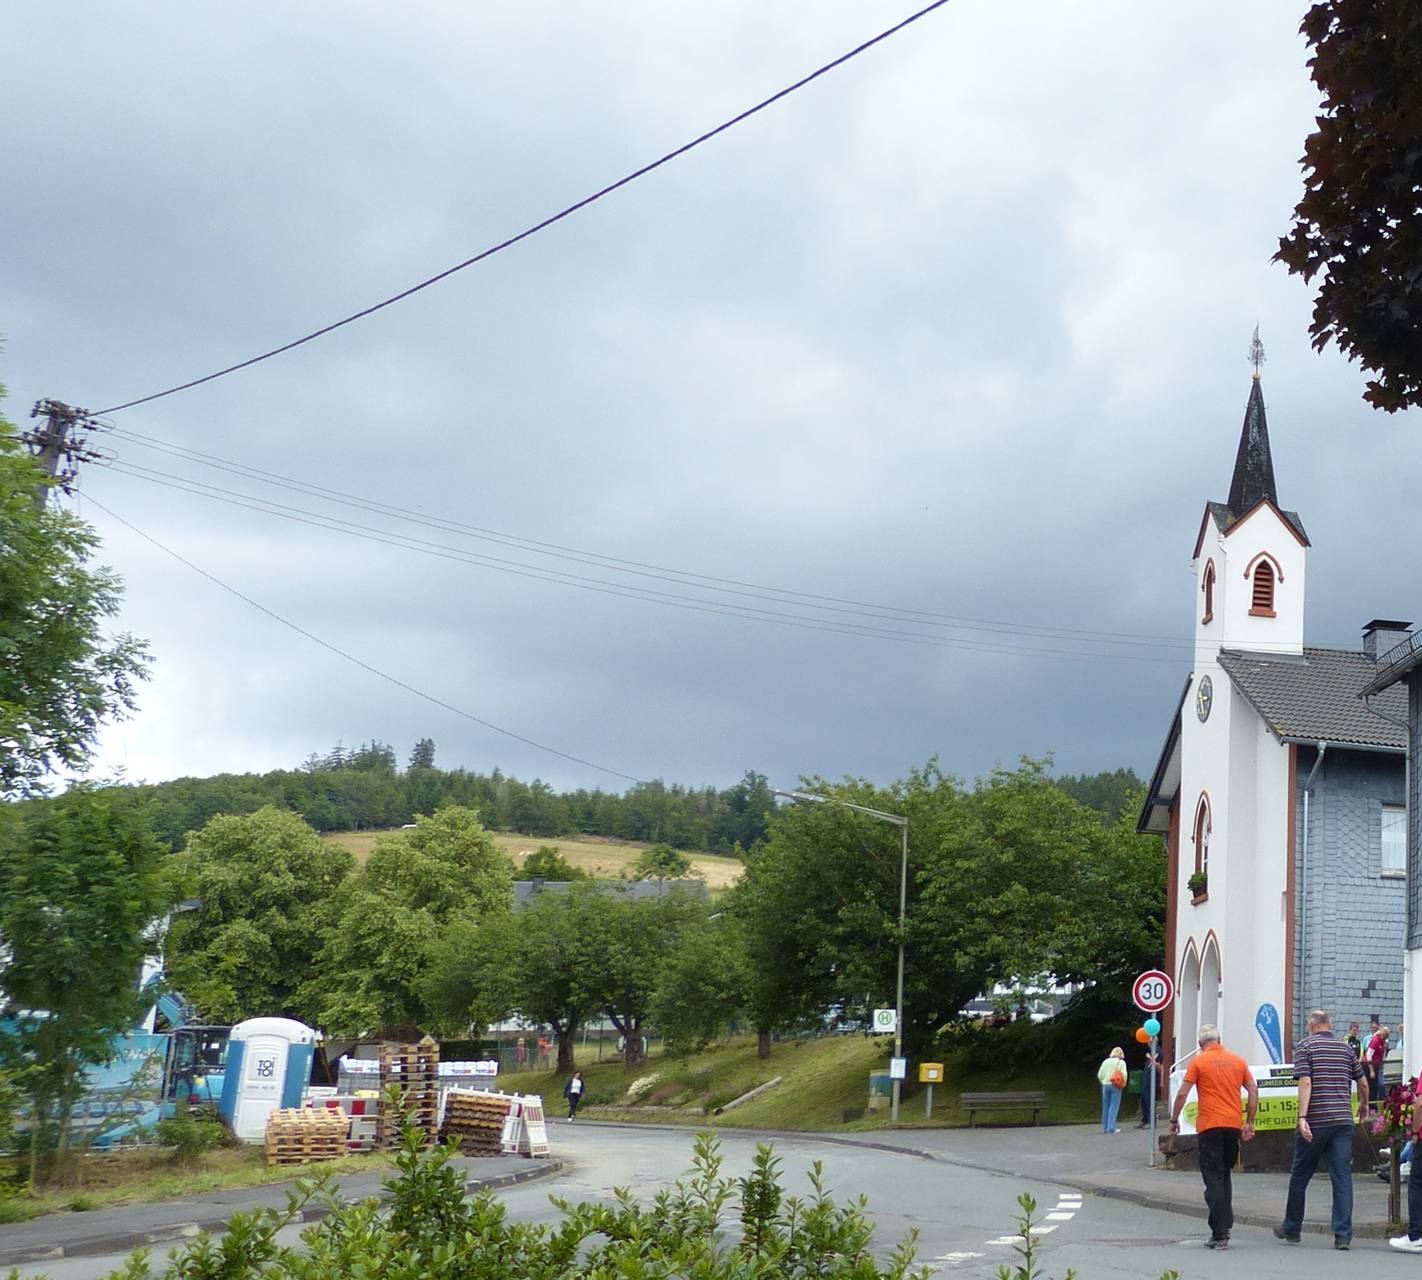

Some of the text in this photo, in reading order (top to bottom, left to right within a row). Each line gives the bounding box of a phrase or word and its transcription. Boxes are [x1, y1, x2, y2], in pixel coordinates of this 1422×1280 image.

[1142, 983, 1163, 1000] 30
[1242, 1101, 1297, 1113] JLI 15:
